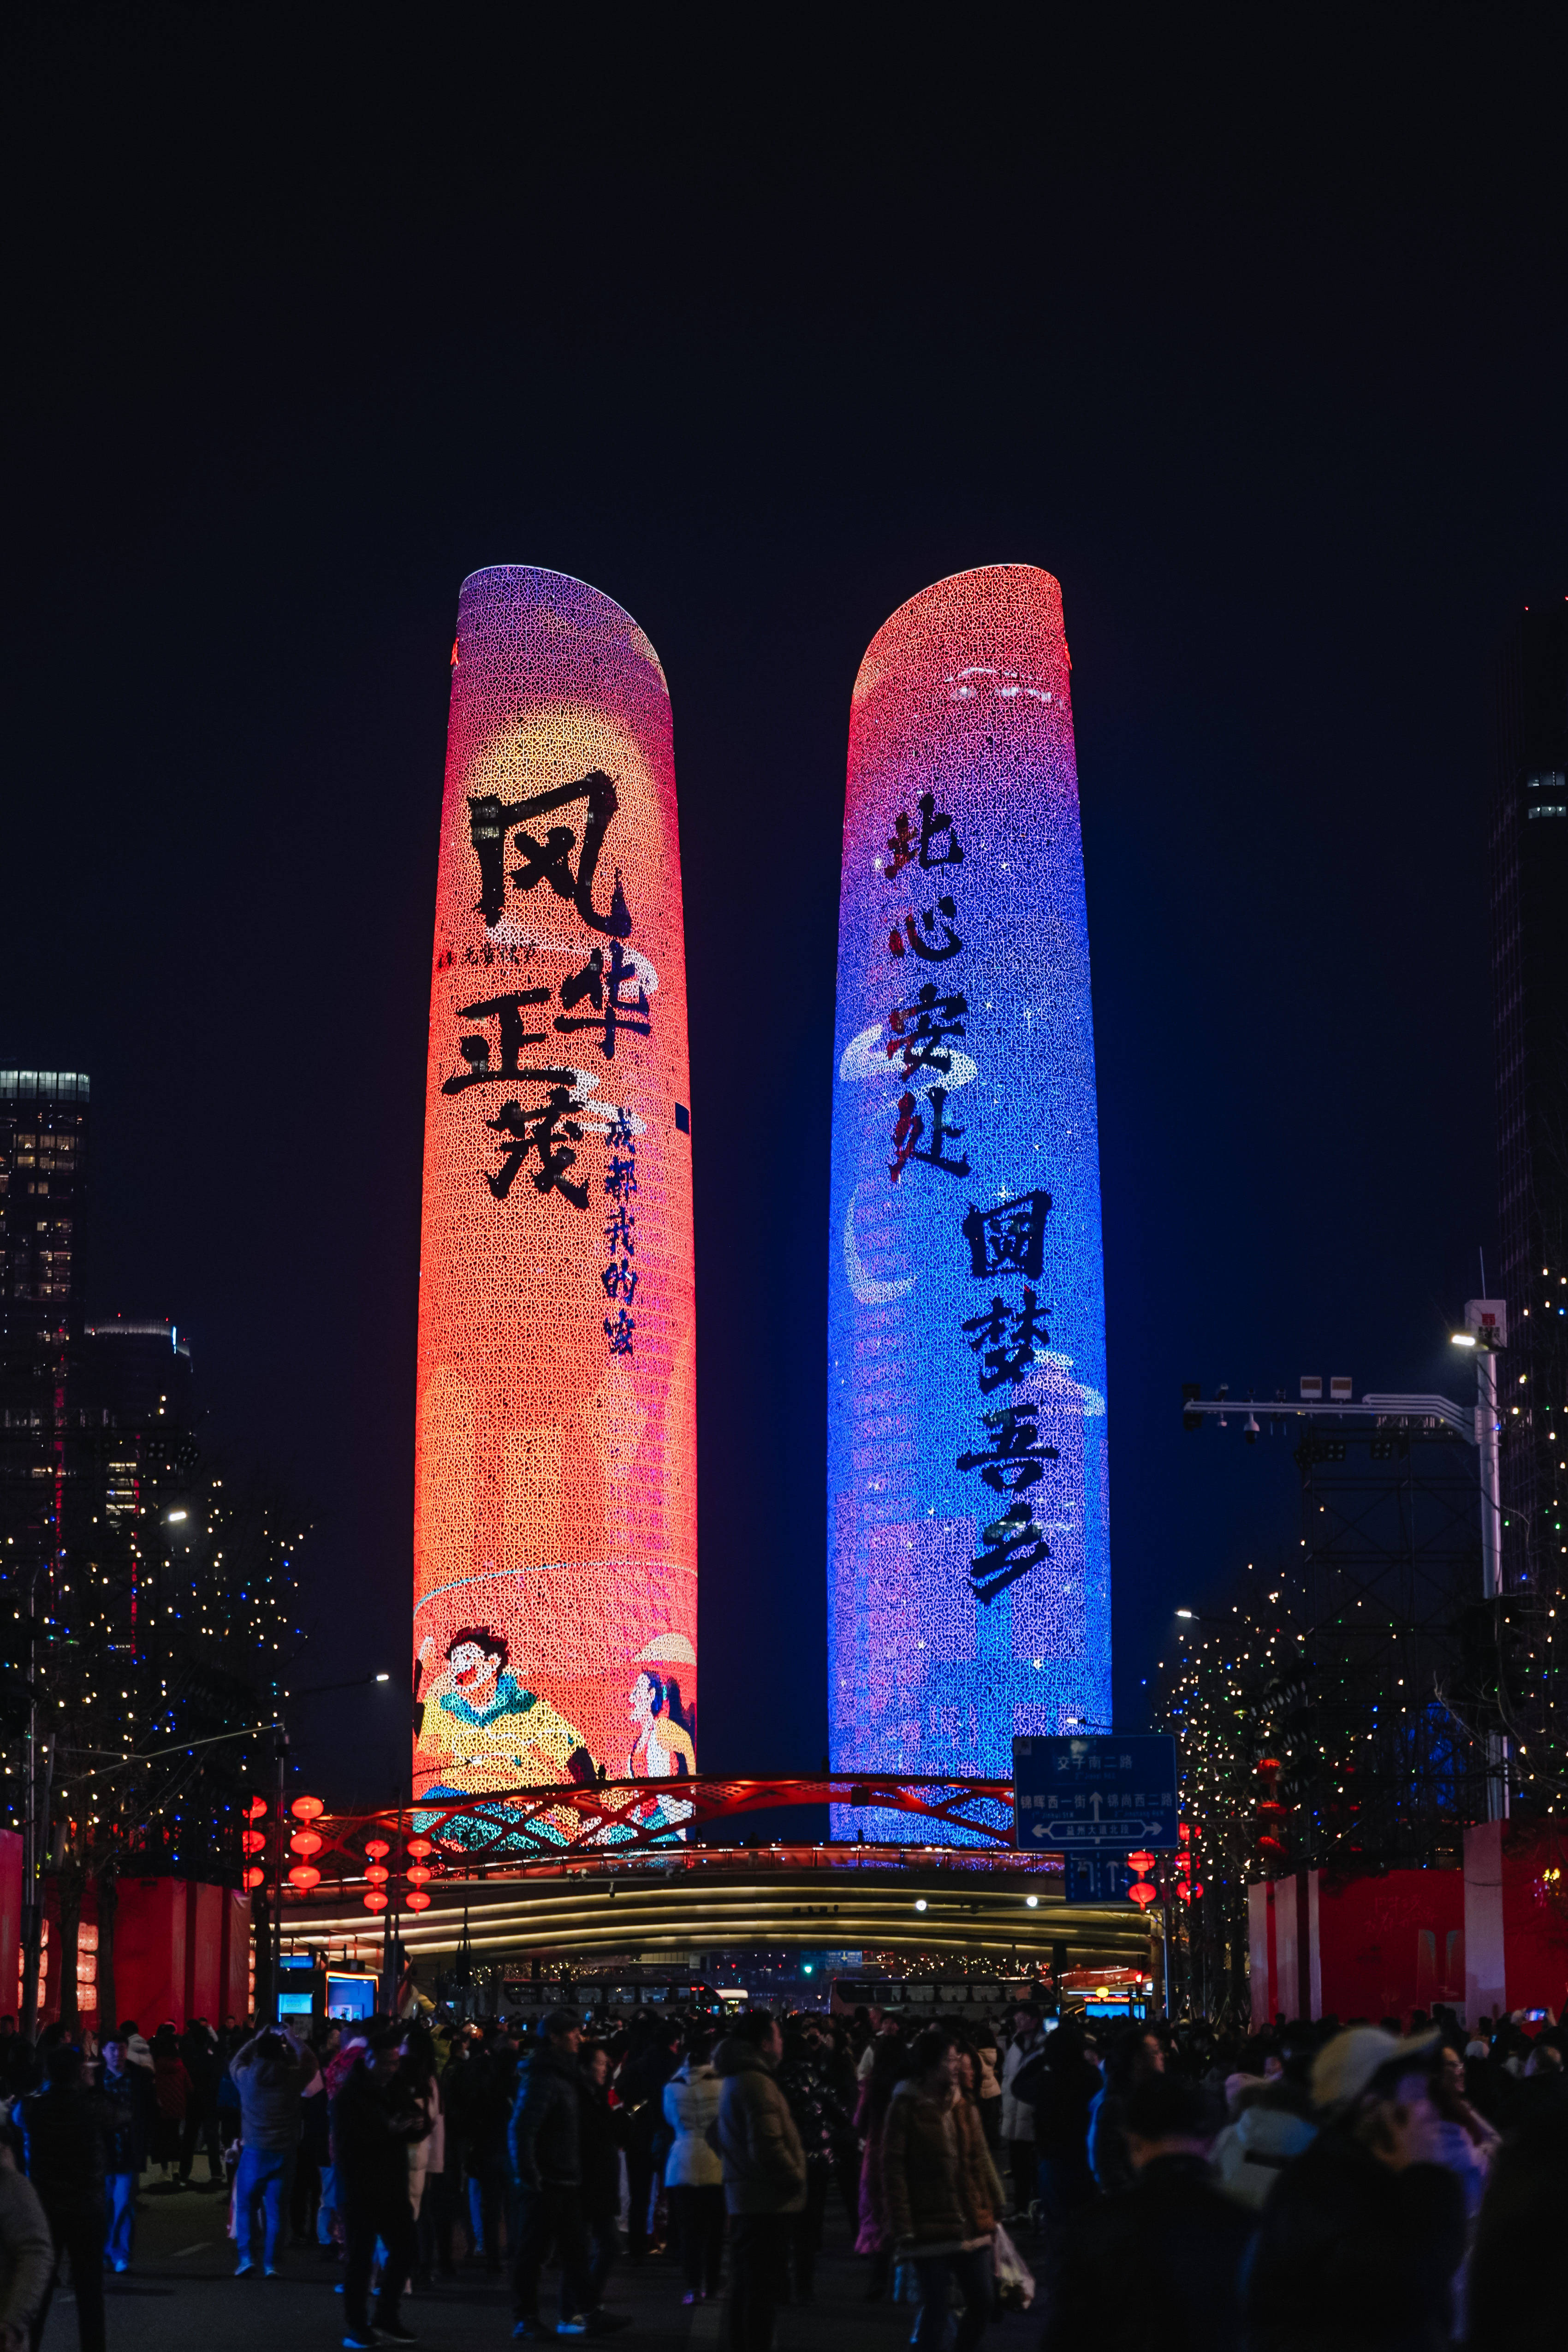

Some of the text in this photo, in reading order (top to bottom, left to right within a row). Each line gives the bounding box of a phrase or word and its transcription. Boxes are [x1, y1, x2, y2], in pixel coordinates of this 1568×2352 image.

[441, 770, 650, 1210] 风华正茂
[884, 792, 971, 1182] 此心安处
[1057, 1755, 1133, 1770] 交子南二路
[1020, 1794, 1085, 1810] 锦晖西一街
[1107, 1793, 1173, 1808] 锦尚西二路
[1066, 1824, 1129, 1836] 益州大道北段
